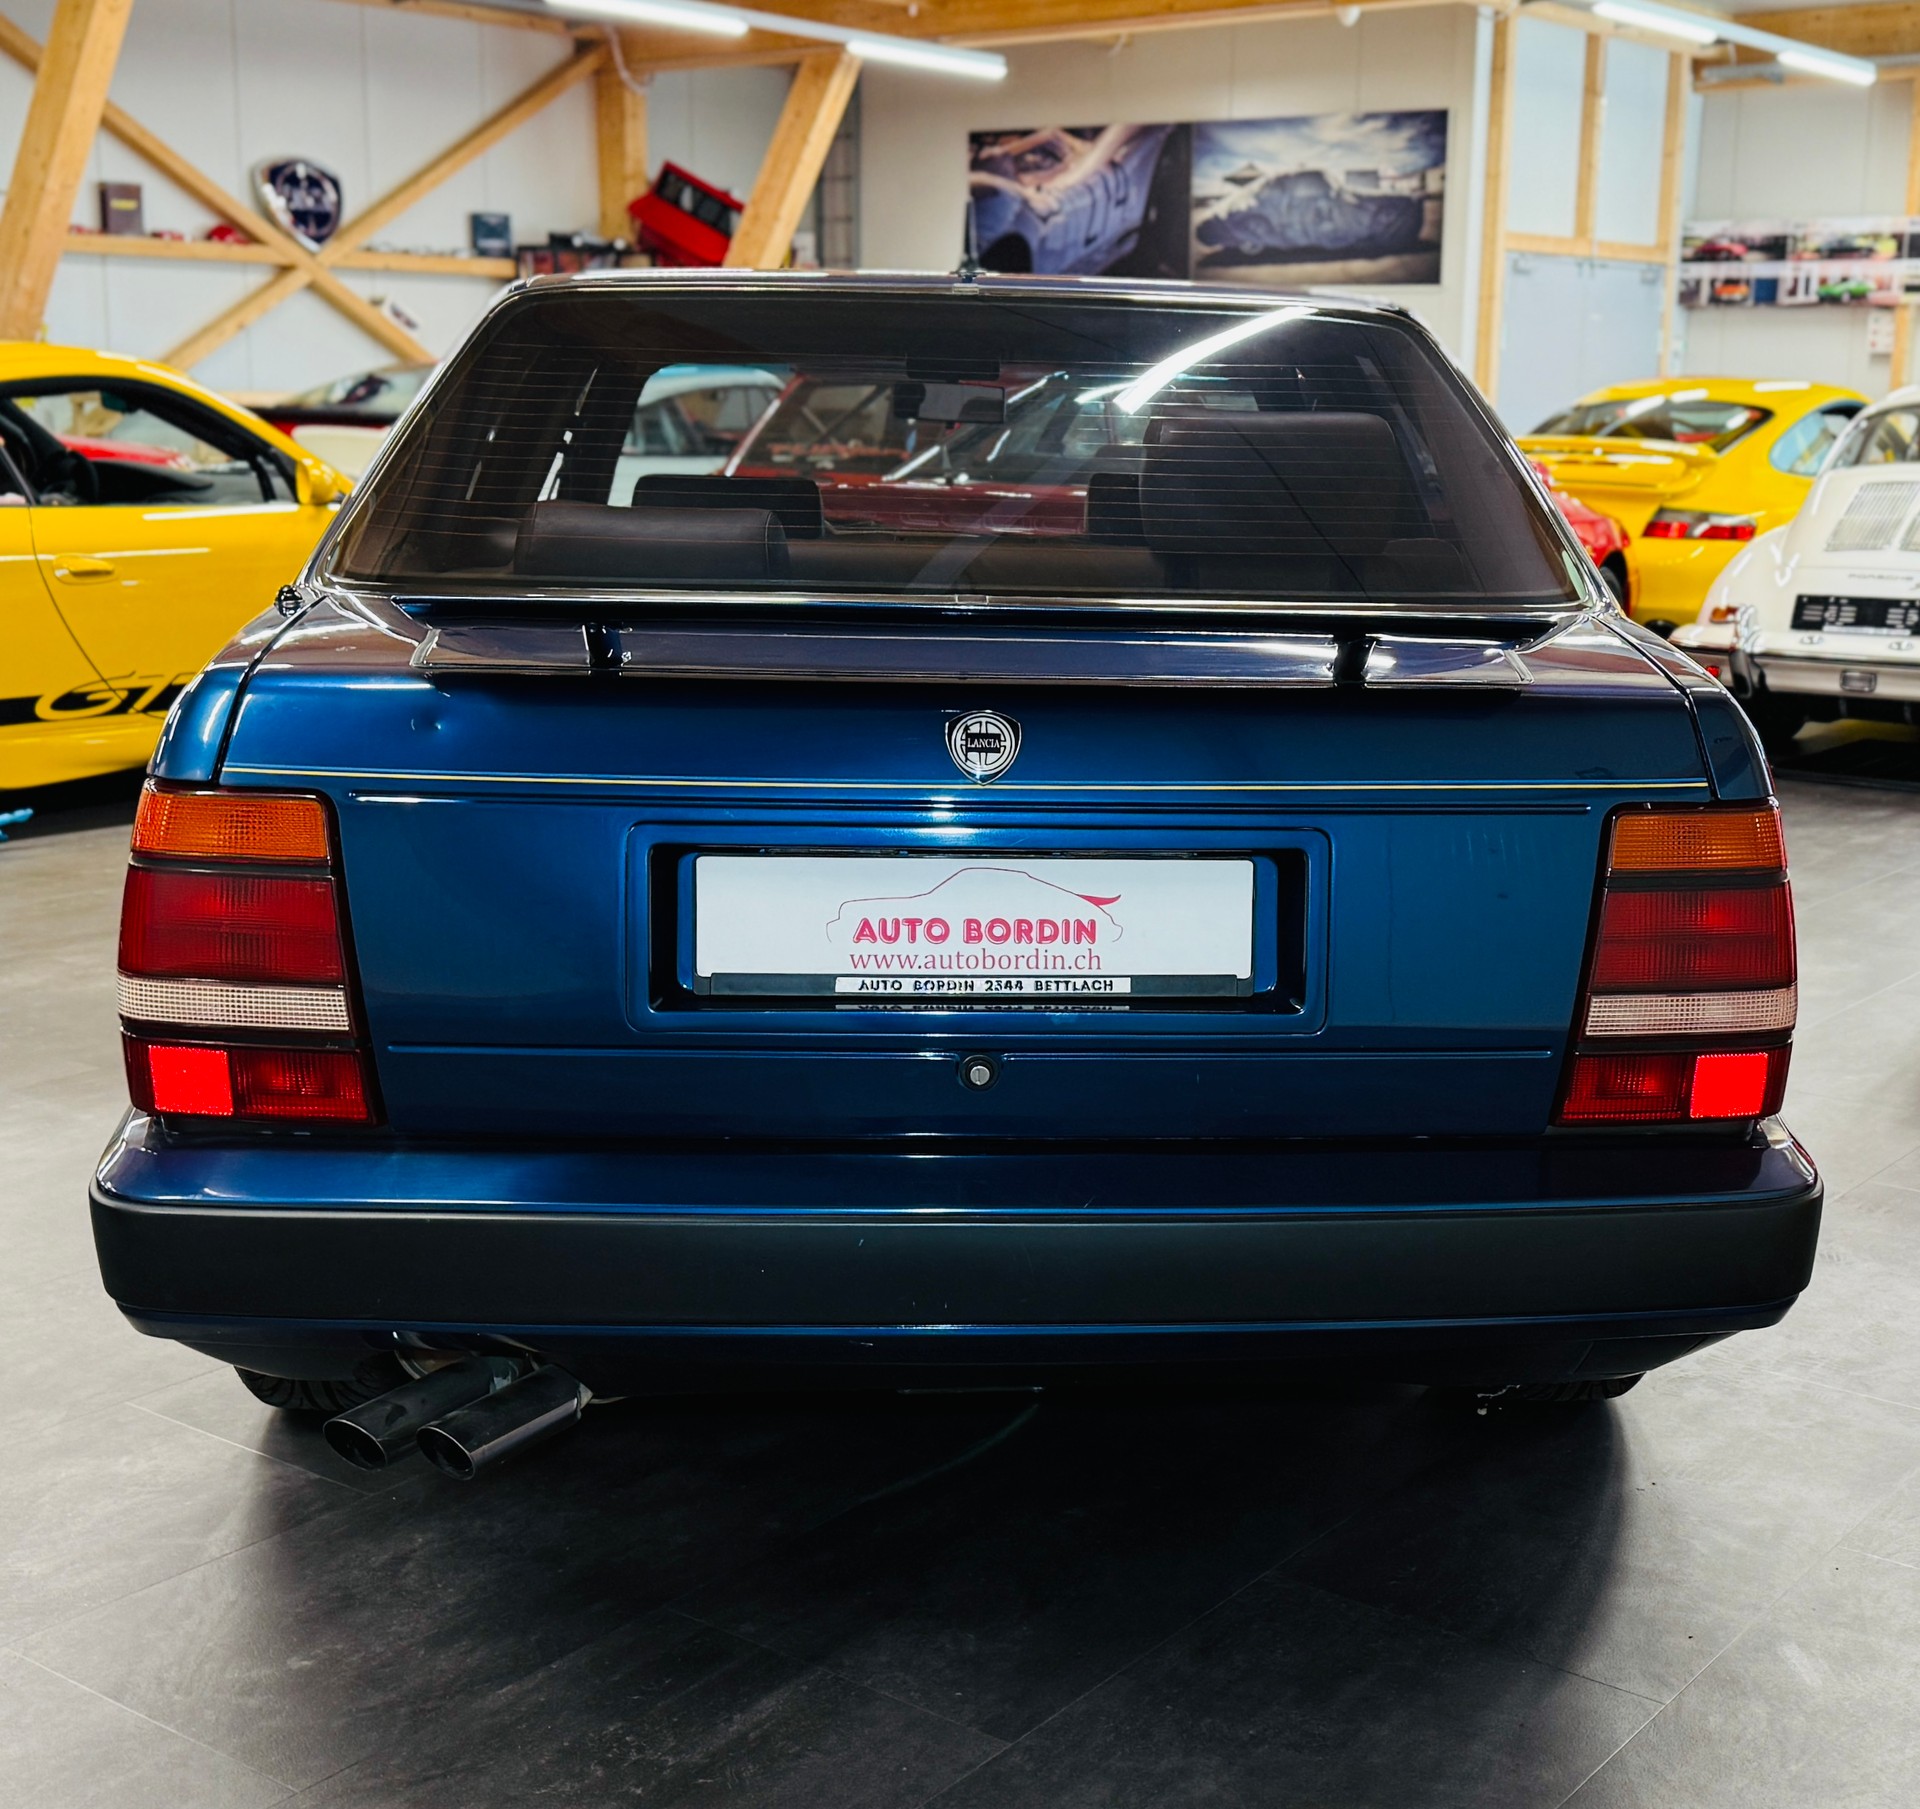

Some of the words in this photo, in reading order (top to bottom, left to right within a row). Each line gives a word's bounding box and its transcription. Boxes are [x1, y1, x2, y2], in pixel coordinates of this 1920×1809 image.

[967, 738, 1000, 748] LANCIA
[853, 917, 950, 944] AUTO
[963, 917, 1096, 945] BORDIN
[849, 949, 1102, 970] www.autobordin.ch
[858, 979, 903, 991] AUTO
[1034, 979, 1113, 992] BETTLACH
